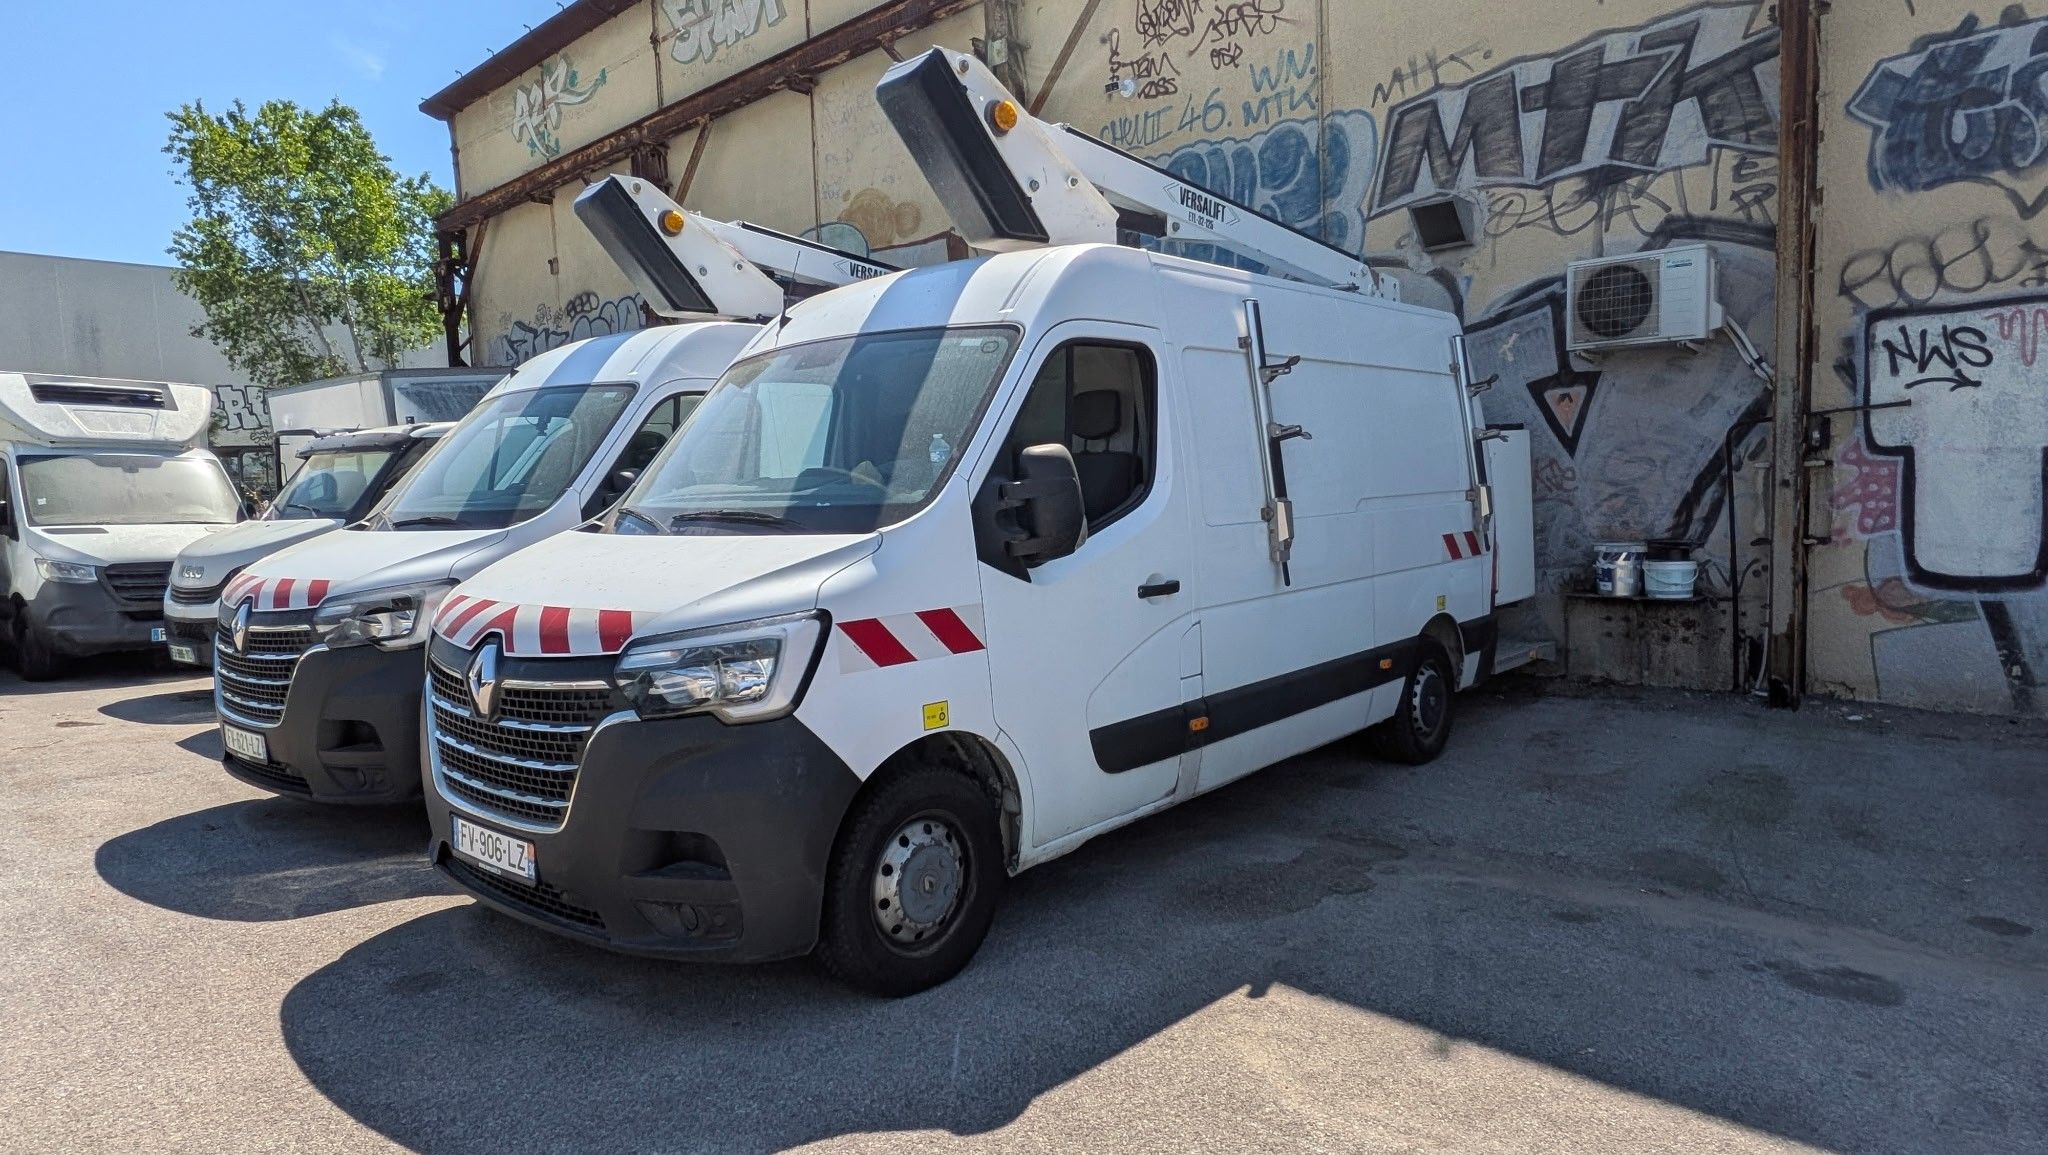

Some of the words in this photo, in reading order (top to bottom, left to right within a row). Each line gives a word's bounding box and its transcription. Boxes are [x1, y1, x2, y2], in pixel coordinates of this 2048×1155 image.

[1180, 186, 1226, 223] VERSALIFT
[850, 261, 890, 281] VERSA
[1882, 319, 1994, 376] NWS
[460, 822, 527, 872] FV-906-LZ
